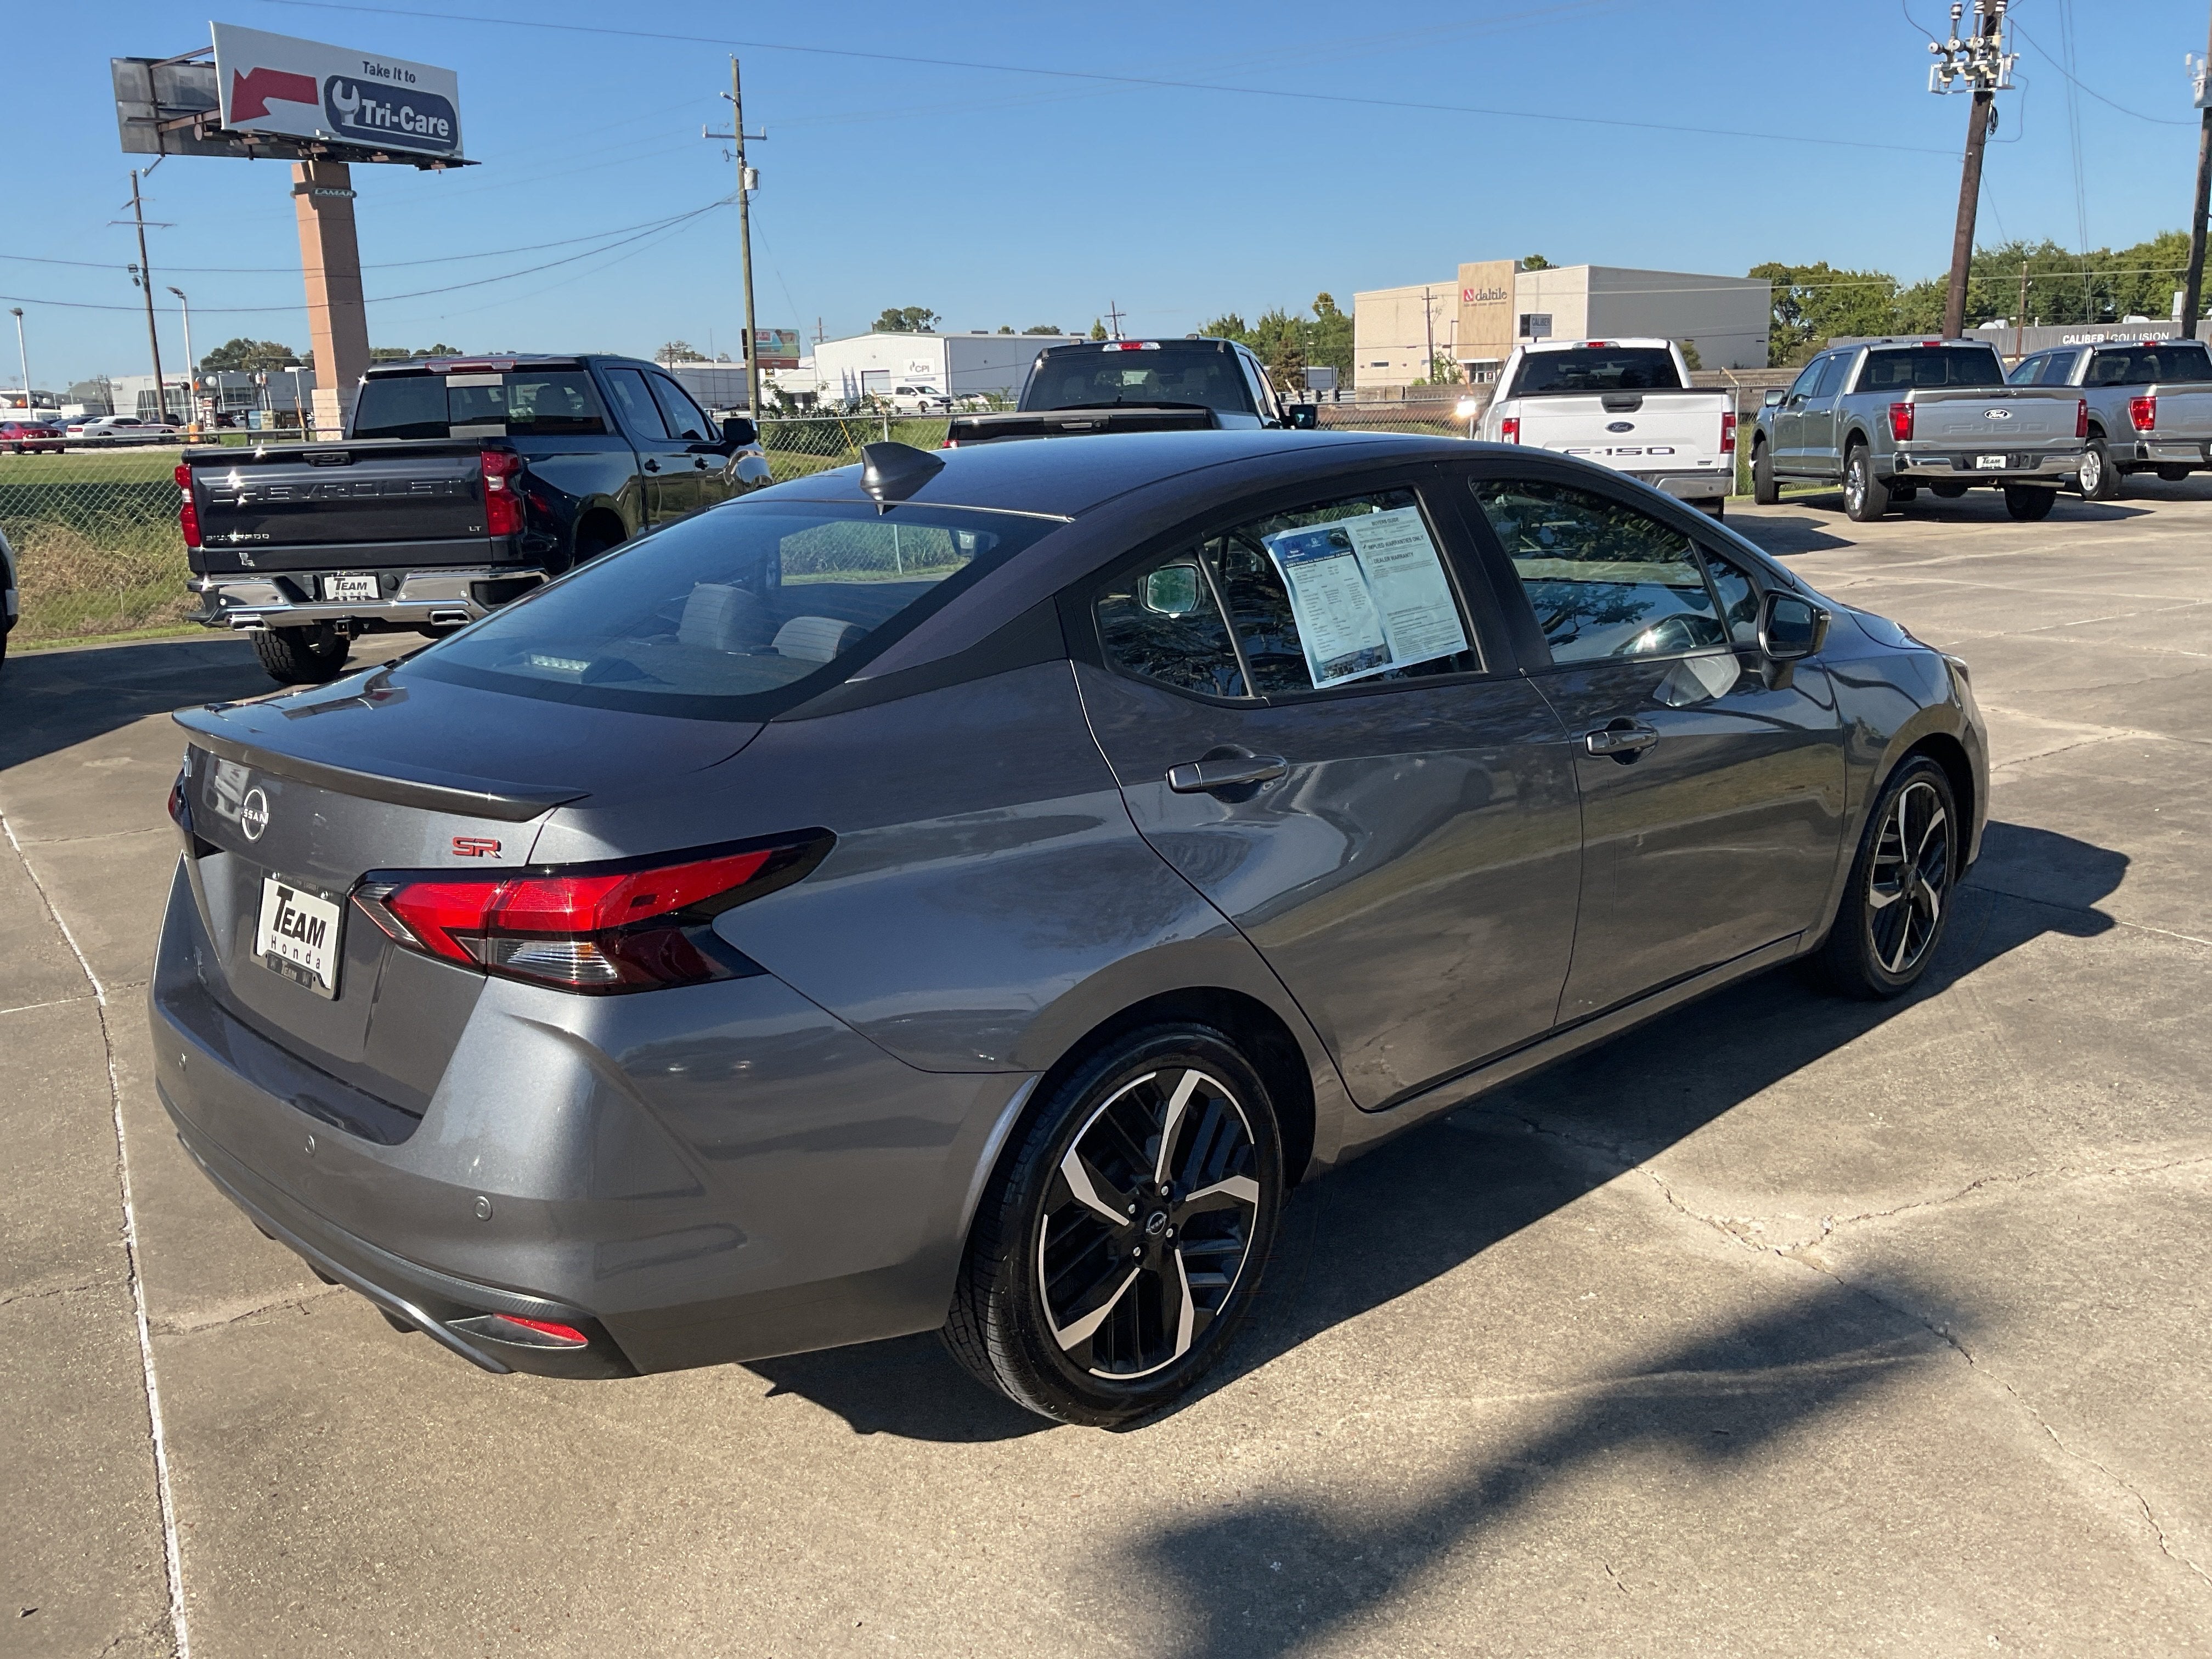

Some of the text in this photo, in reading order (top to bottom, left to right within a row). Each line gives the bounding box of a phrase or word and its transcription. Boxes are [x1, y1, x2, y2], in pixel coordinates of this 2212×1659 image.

[362, 61, 416, 83] Take It to
[362, 99, 449, 137] Tri-Care
[1475, 287, 1508, 301] daltile
[2062, 332, 2170, 345] CALIBER COLLISION
[1943, 422, 2049, 434] F-150
[1564, 447, 1675, 456] F-150
[211, 478, 464, 504] CHEVROLET
[1391, 552, 1414, 561] WARRANTY
[334, 577, 368, 590] TEAM
[240, 808, 269, 825] SSAN
[453, 837, 502, 859] SR
[273, 885, 326, 949] TEAM
[271, 935, 320, 970] Honda
[281, 960, 297, 981] TEAM
